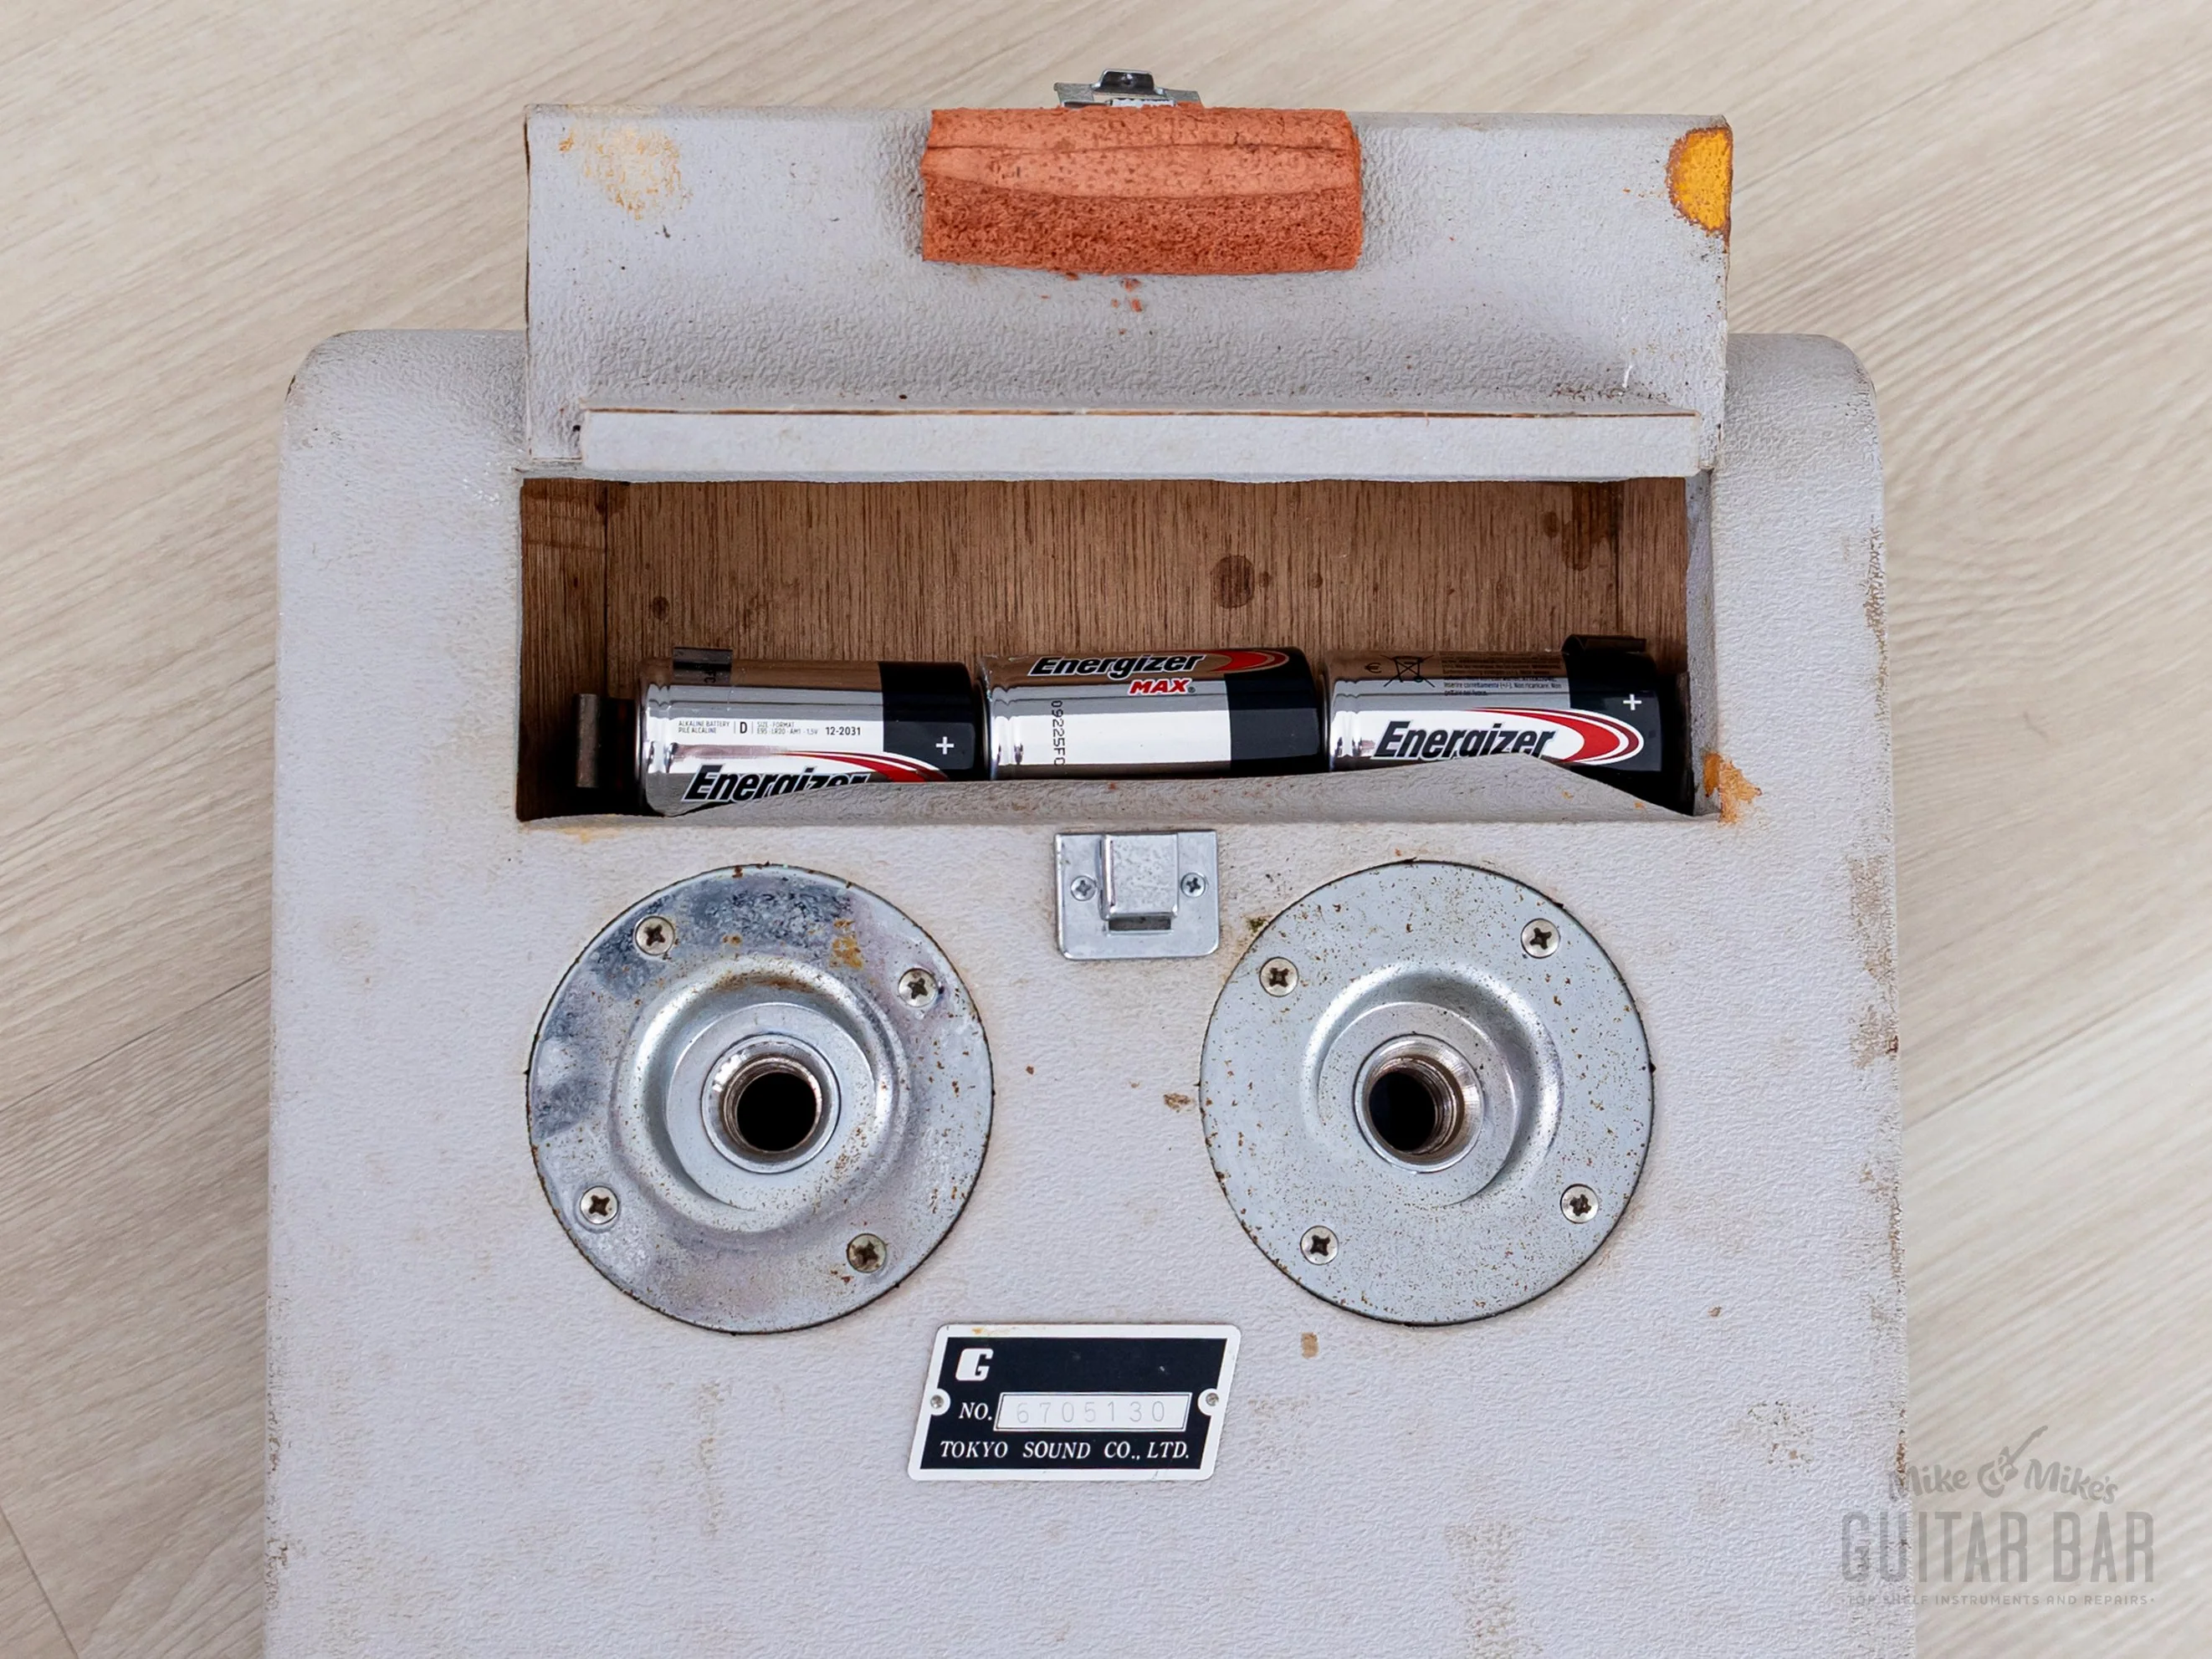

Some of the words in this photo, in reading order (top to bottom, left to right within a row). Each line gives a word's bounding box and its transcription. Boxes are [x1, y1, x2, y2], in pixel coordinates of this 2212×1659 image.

[1028, 654, 1208, 680] Energizer
[740, 721, 748, 734] D
[825, 726, 861, 736] 12-2031
[1371, 720, 1558, 760] Energizer
[955, 1348, 994, 1381] G
[959, 1402, 993, 1421] NO.
[1016, 1400, 1165, 1424] 6705130
[940, 1441, 1008, 1458] TOKYO
[1022, 1441, 1091, 1459] SOUND
